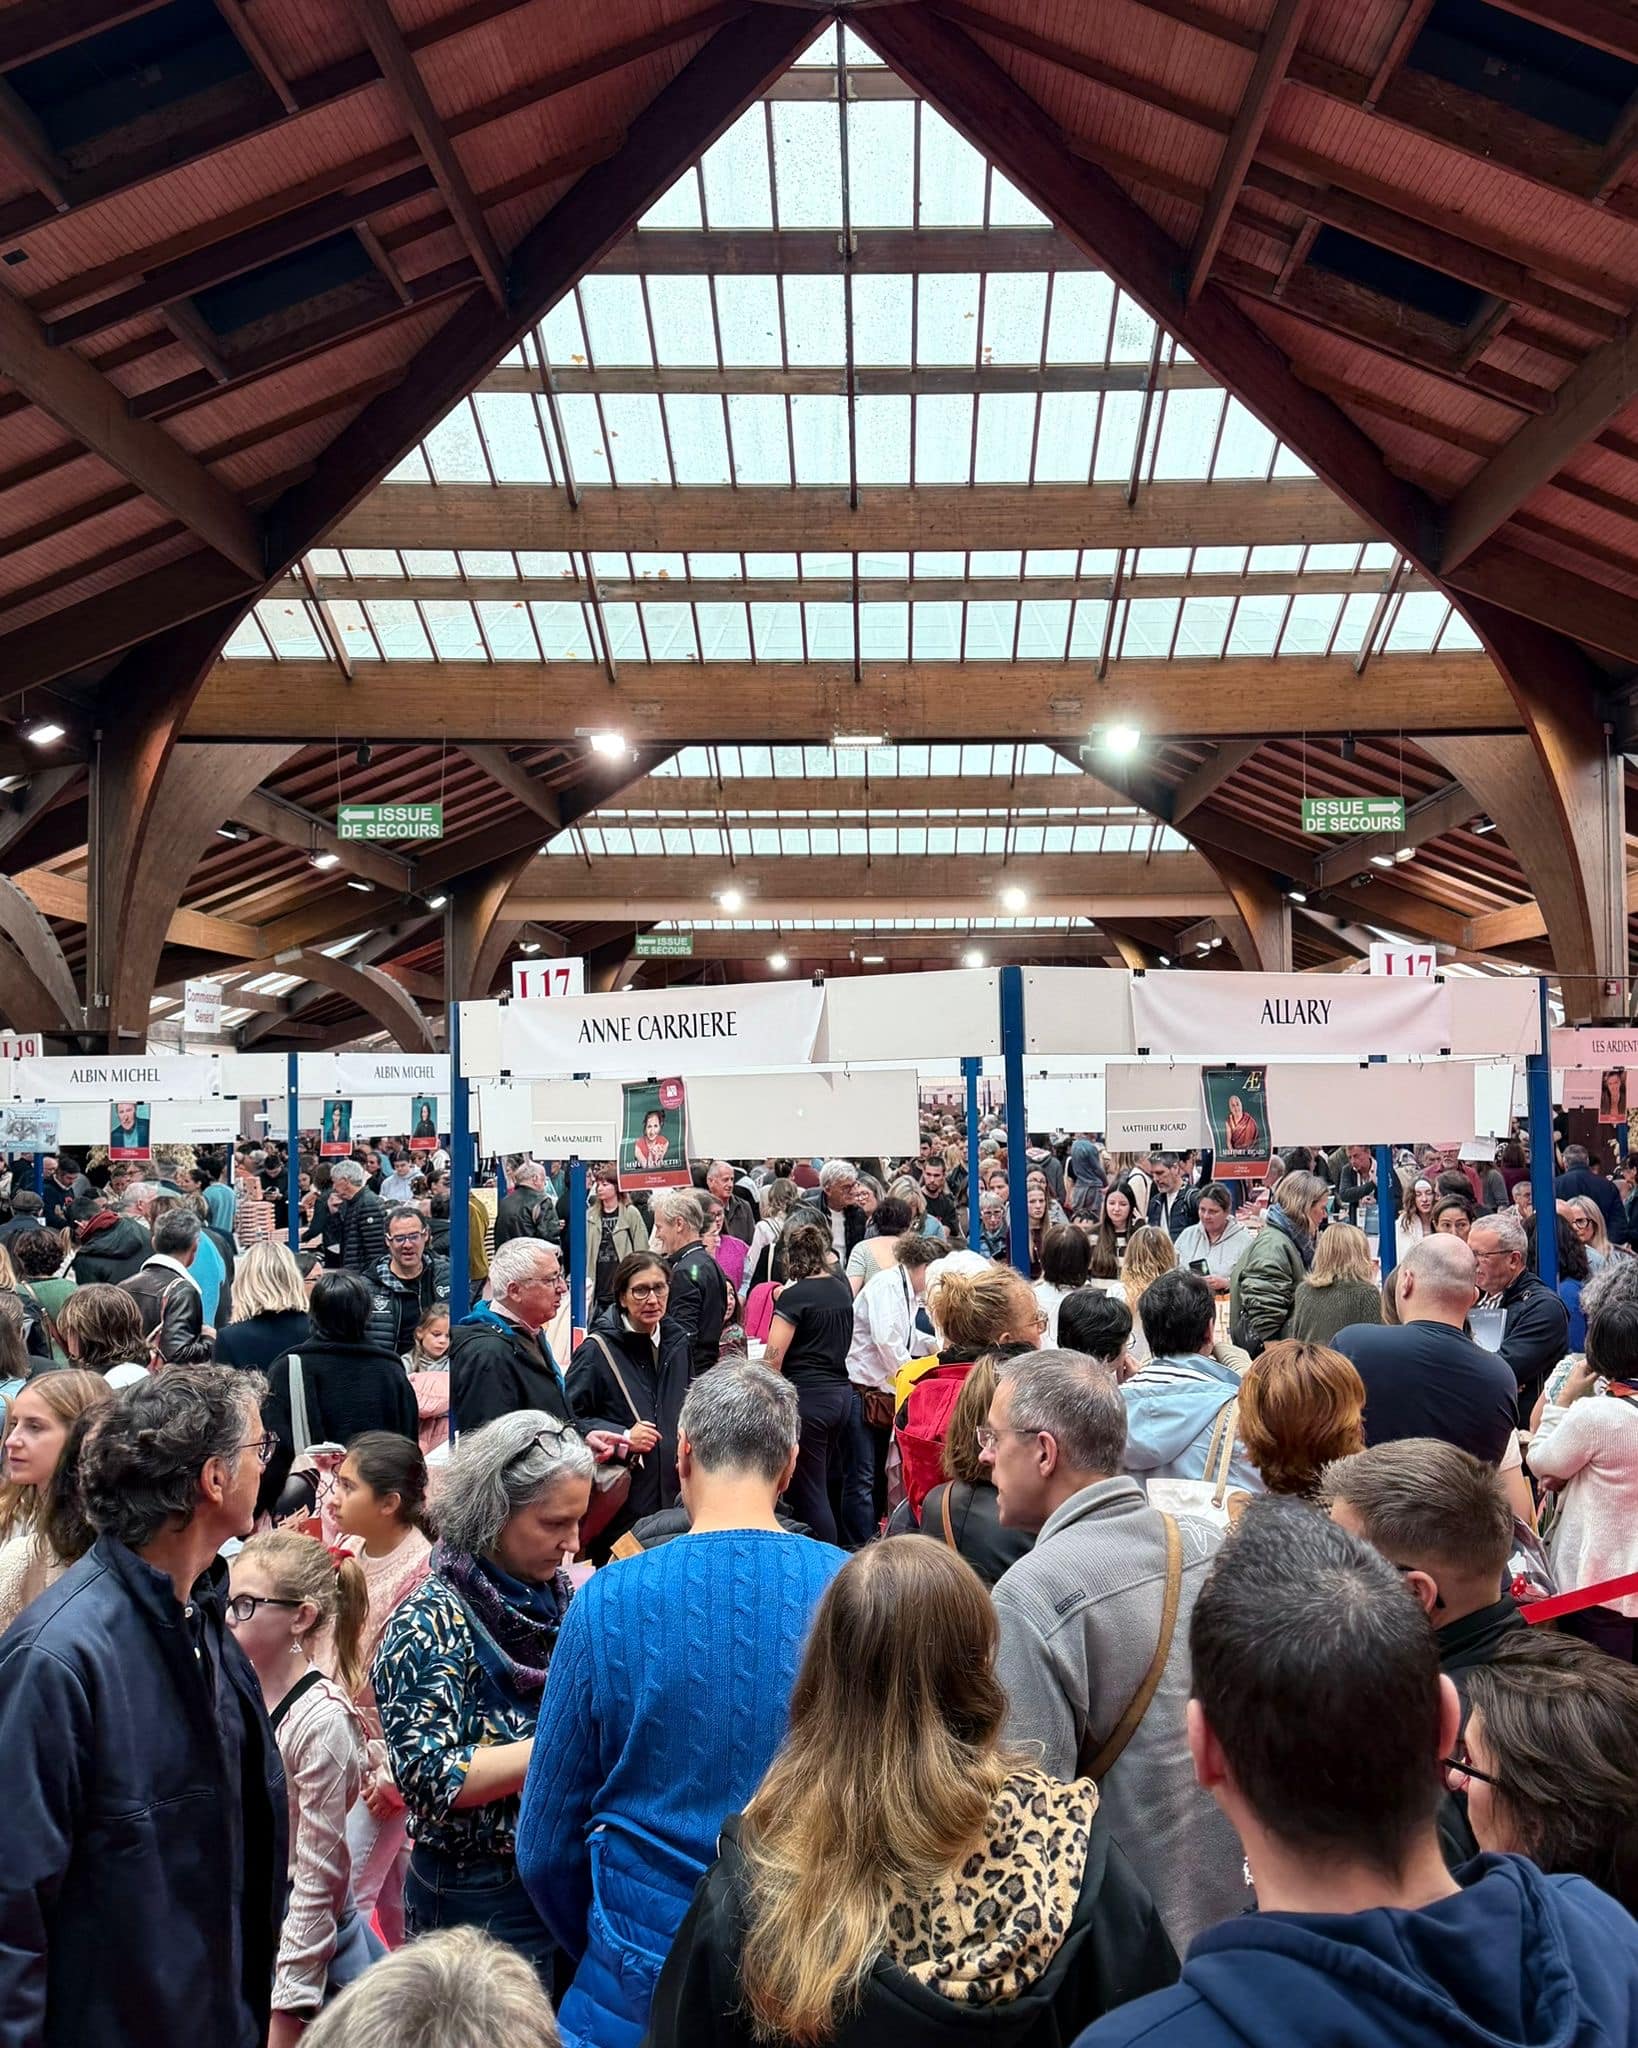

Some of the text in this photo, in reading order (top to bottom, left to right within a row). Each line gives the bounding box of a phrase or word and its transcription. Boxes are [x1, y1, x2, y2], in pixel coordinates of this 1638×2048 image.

[378, 807, 433, 821] ISSUE
[1311, 801, 1364, 816] ISSUE
[341, 823, 440, 837] DE SECOURS
[1306, 816, 1401, 831] DE SECOURS
[657, 937, 689, 946] ISSUE
[637, 946, 692, 955] DE SECOURS
[1261, 999, 1332, 1025] ALLARY
[578, 1011, 738, 1044] ANNE CARRIERE
[1592, 1040, 1606, 1053] LES
[70, 1067, 161, 1084] ALBIN MICHEL
[374, 1065, 436, 1079] ALBIN MICHEL
[1122, 1123, 1187, 1133] MATTHIEU RICARD
